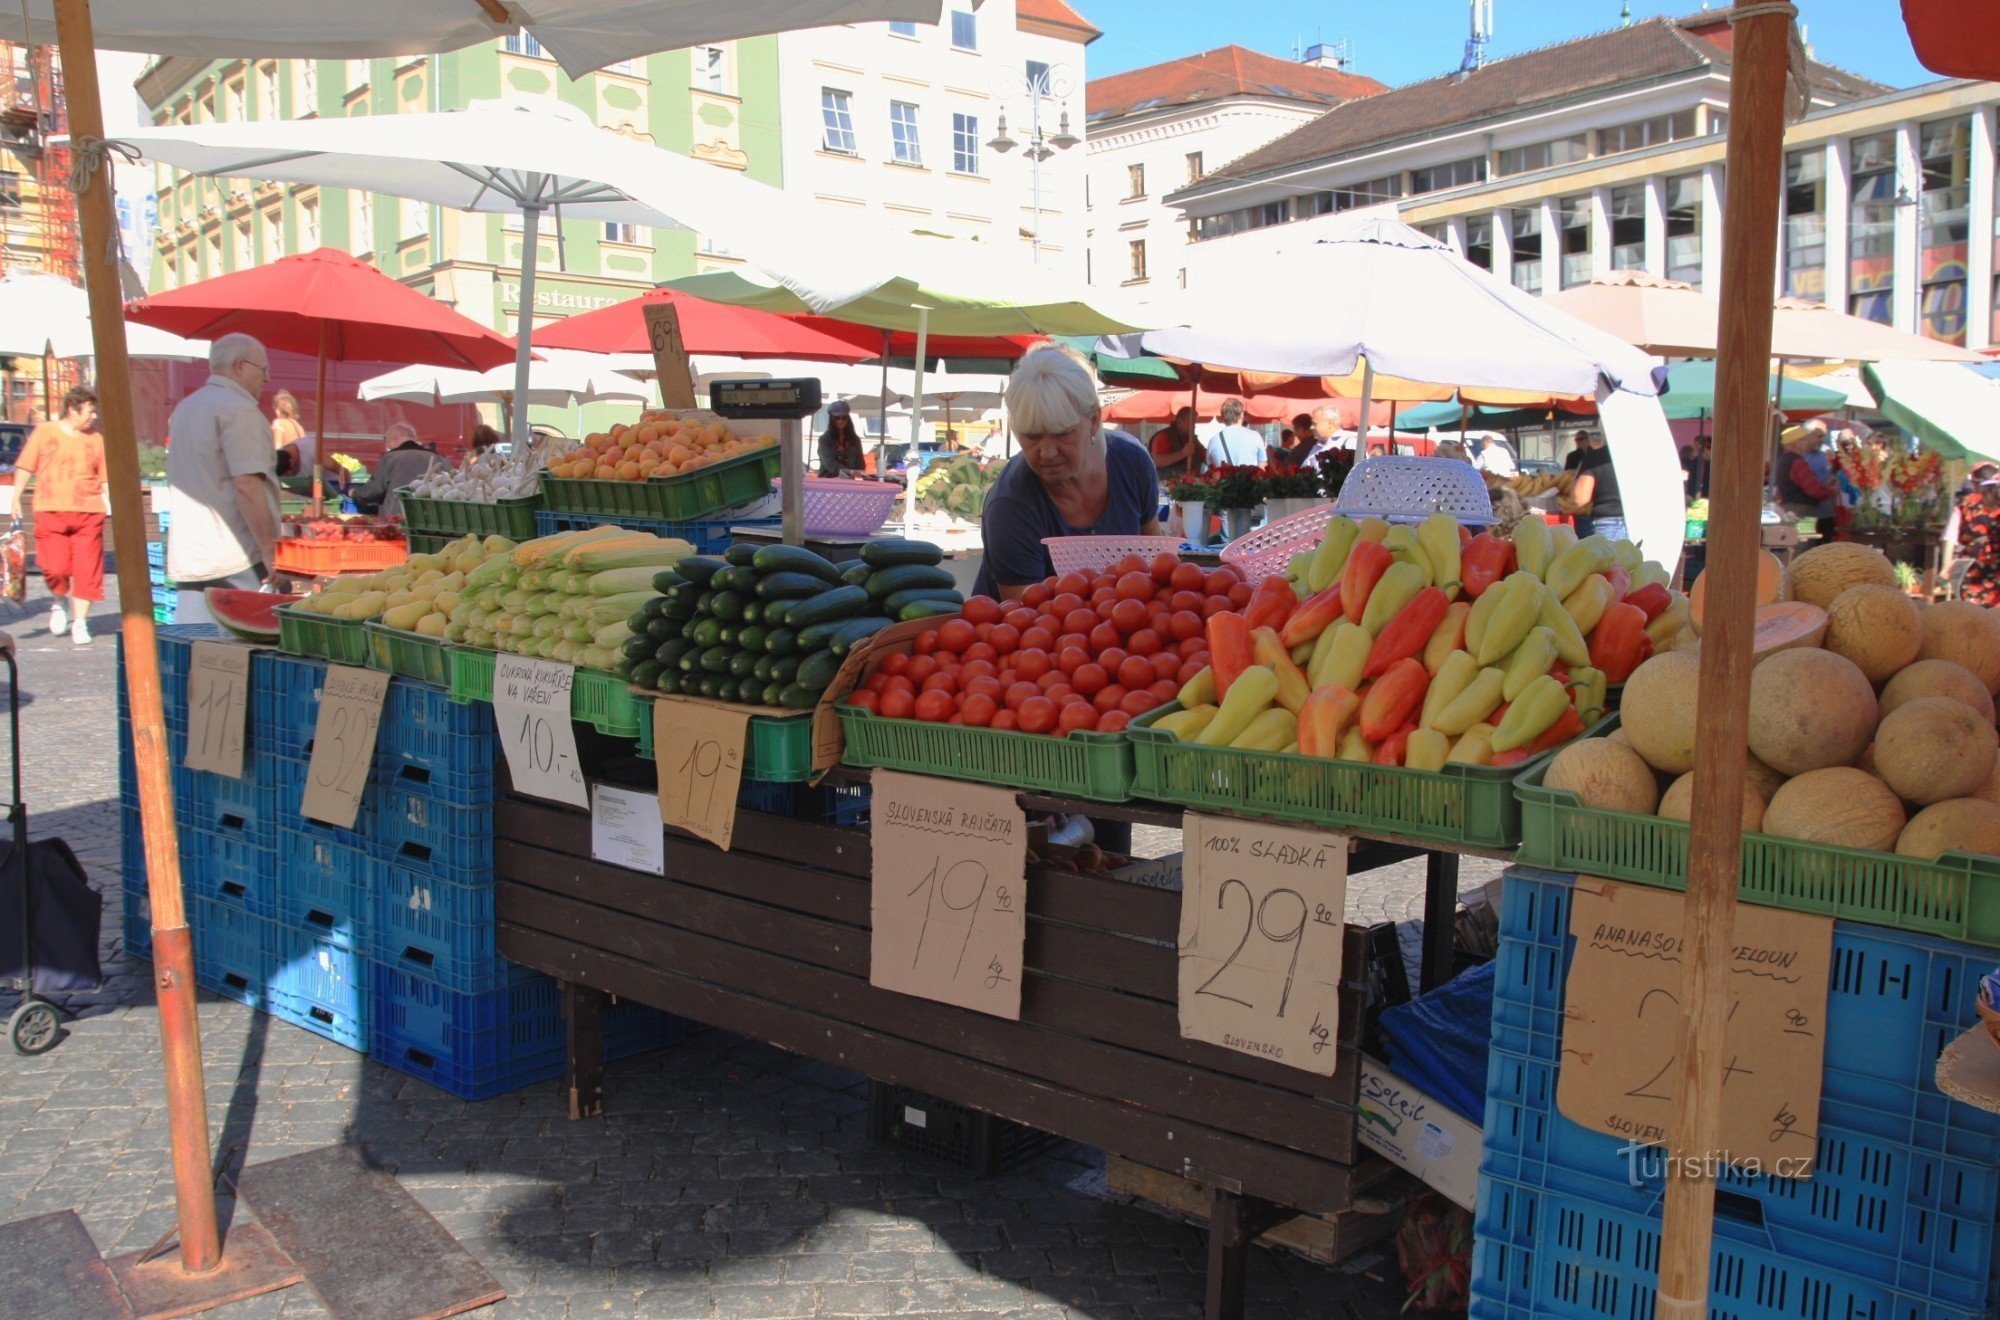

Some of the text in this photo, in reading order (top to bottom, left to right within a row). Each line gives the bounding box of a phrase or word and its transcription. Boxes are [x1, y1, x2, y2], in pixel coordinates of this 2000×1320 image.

[502, 281, 618, 310] Rstaura
[653, 320, 673, 352] 69
[507, 684, 518, 700] NA
[200, 679, 232, 760] 11
[316, 707, 368, 795] 32
[679, 740, 722, 822] 19
[885, 801, 1012, 835] SLOVENSKÁ RAJČATA
[1205, 835, 1337, 869] 100% SLADKÁ
[996, 885, 1012, 909] 90
[1315, 903, 1332, 922] 90
[907, 855, 988, 980] 19
[1195, 879, 1308, 1018] 29
[1732, 946, 1798, 969] ELOUN
[984, 953, 1012, 990] kg
[1309, 1012, 1332, 1055] kg
[1785, 1008, 1808, 1027] 90
[1223, 1033, 1284, 1059] SLOVENSKO
[1605, 1113, 1667, 1141] SLOVEN
[1769, 1102, 1816, 1142] kg
